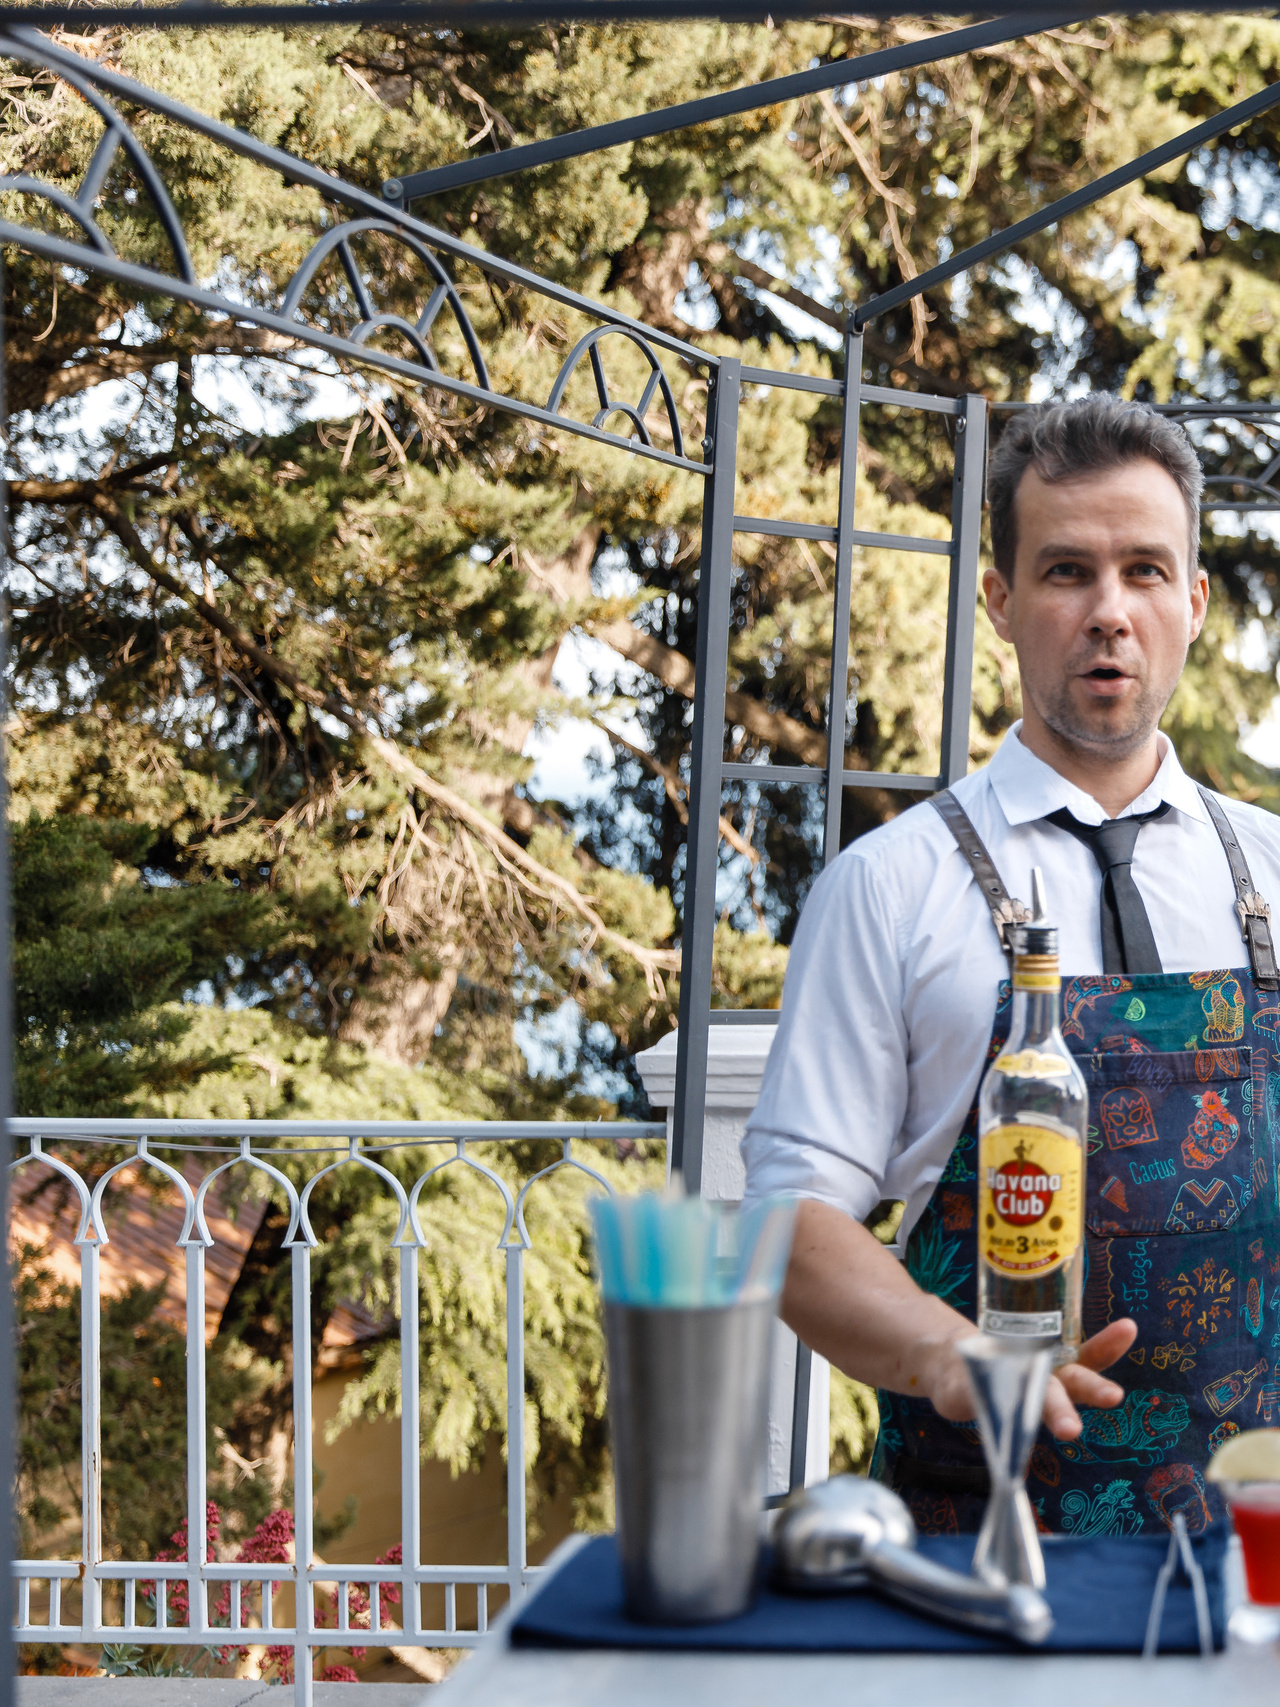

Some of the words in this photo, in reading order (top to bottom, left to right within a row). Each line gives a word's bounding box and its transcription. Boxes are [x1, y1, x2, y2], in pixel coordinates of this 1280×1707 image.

[986, 1166, 1062, 1192] Havana
[1128, 1157, 1177, 1185] Cactus
[996, 1193, 1045, 1215] Club
[1016, 1235, 1030, 1254] 3
[1122, 1238, 1152, 1301] Fiesta
